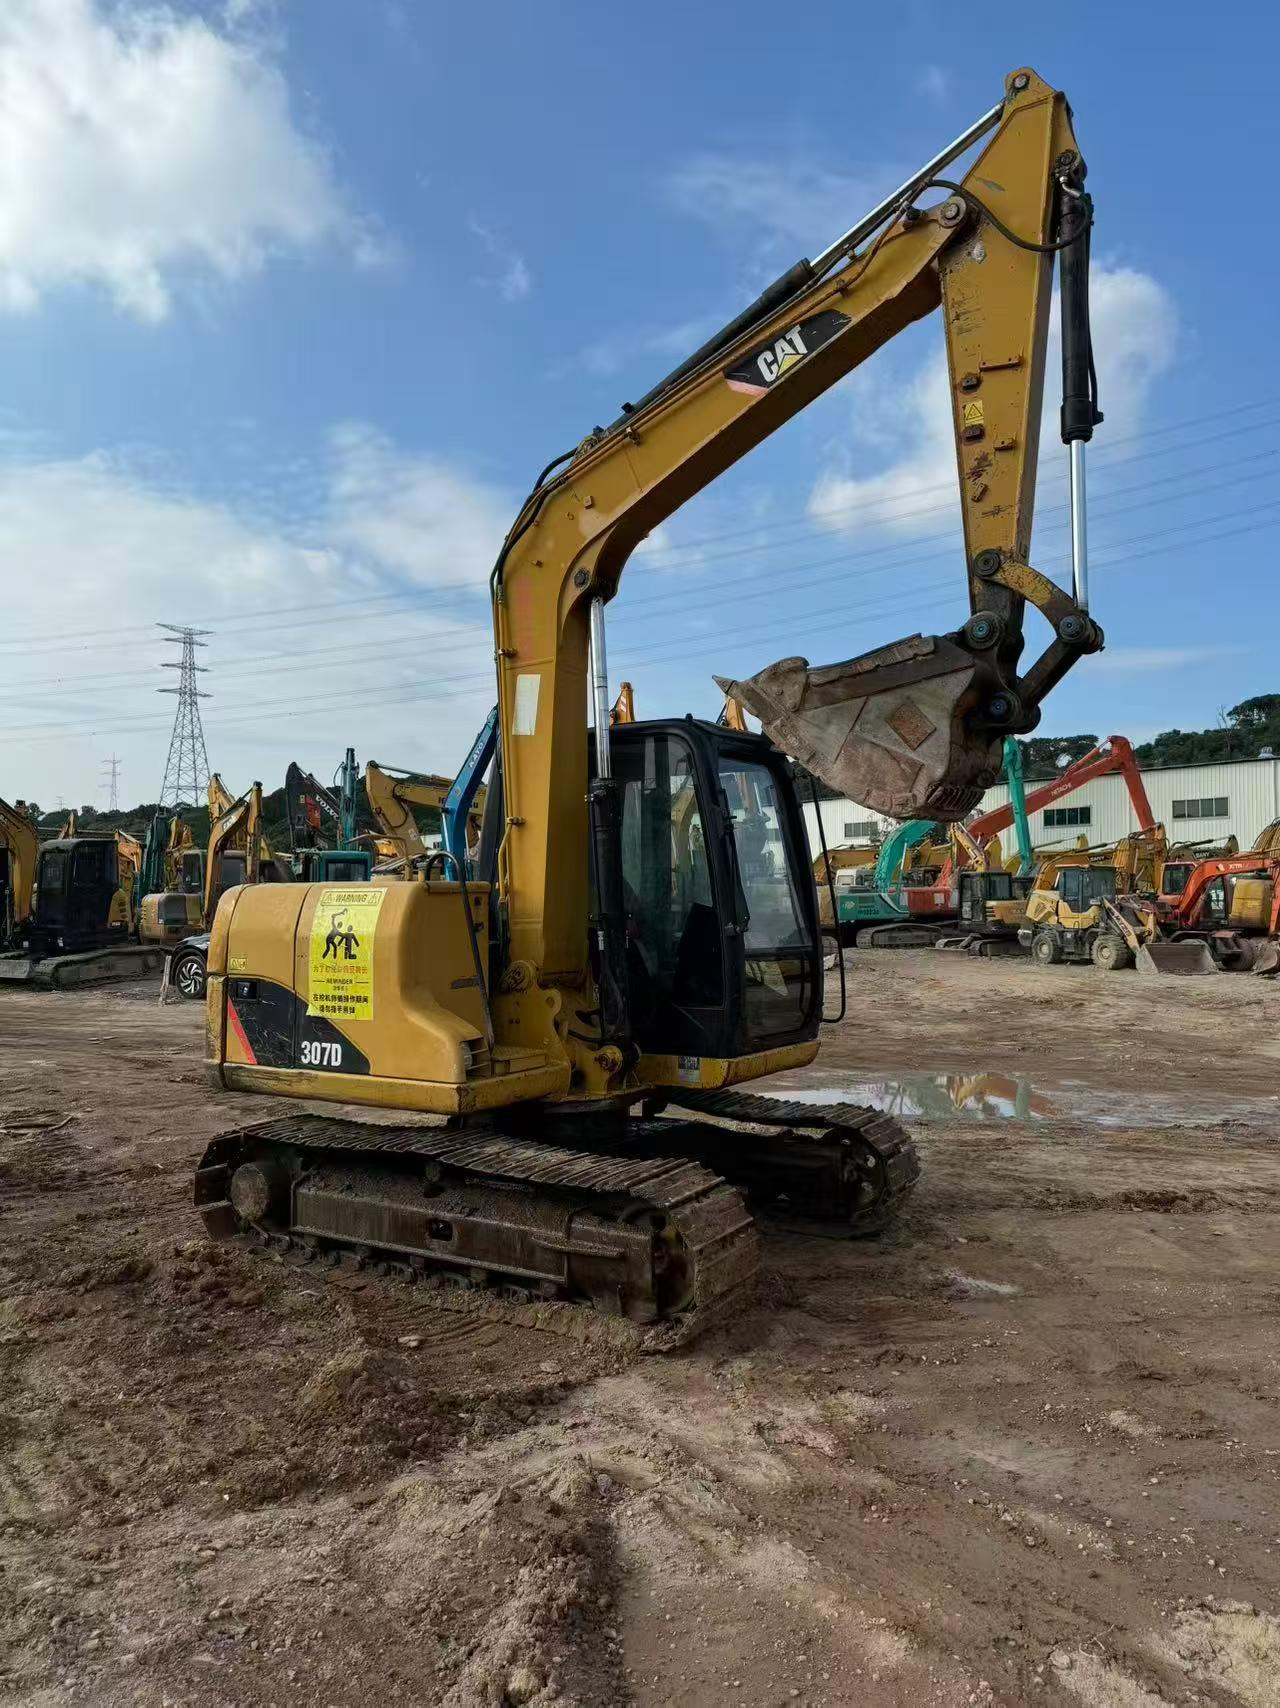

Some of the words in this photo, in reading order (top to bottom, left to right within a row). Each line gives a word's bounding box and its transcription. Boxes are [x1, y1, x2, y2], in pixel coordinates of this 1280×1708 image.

[756, 324, 808, 383] CAT
[469, 742, 484, 768] KATO
[315, 795, 340, 821] VOLVO
[335, 893, 368, 903] WARNING
[301, 1041, 342, 1067] 307D
